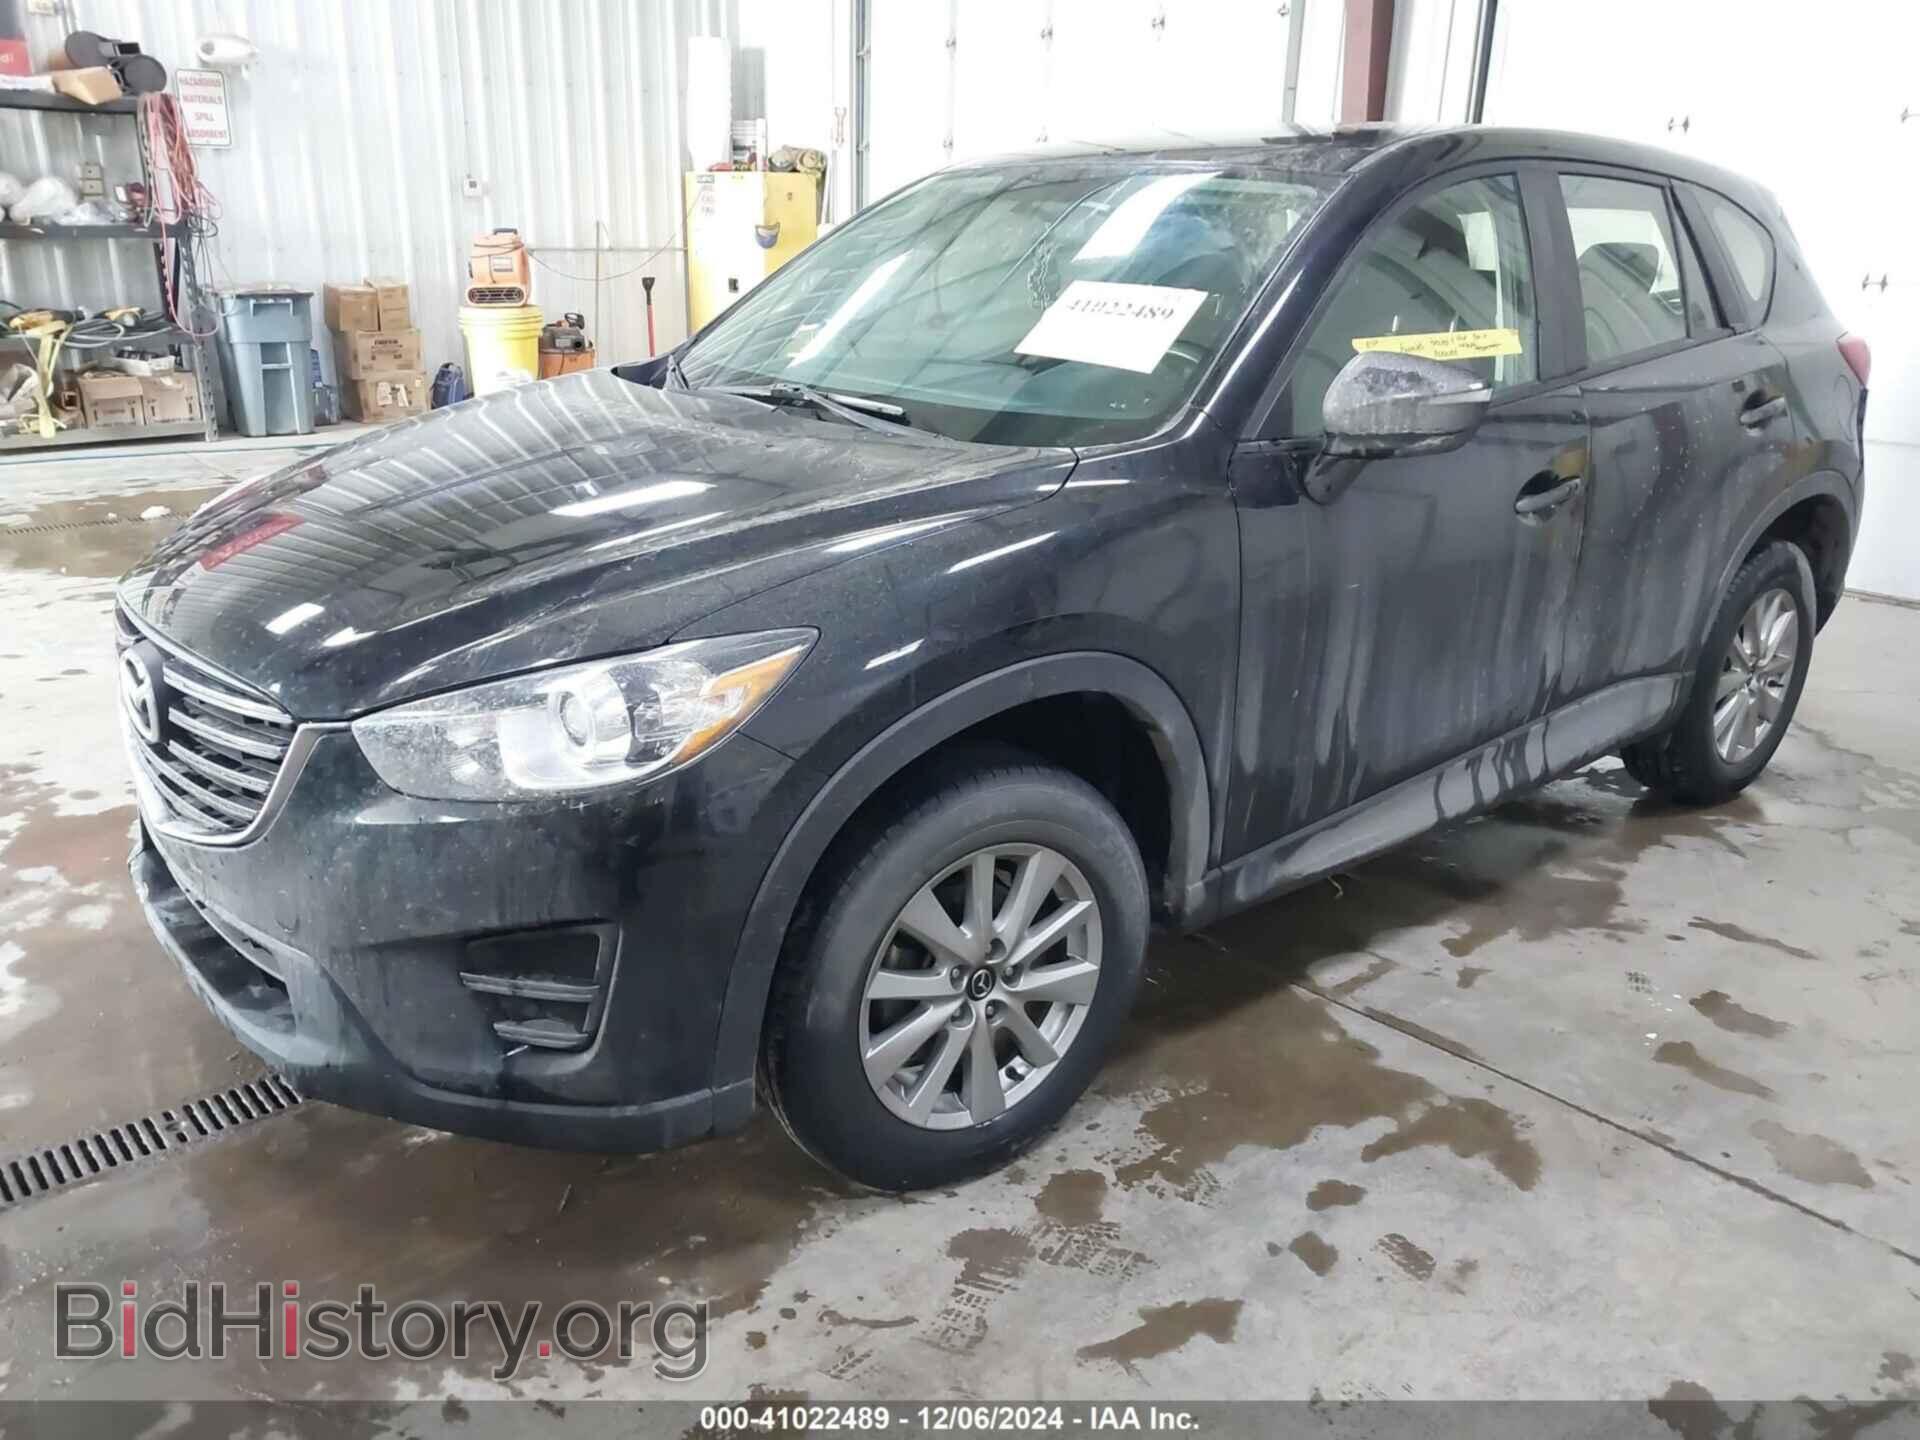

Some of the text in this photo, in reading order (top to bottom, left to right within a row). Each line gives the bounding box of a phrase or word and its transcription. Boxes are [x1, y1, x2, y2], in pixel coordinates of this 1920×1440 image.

[183, 95, 223, 104] MATERIALS
[194, 112, 216, 121] SPILL
[1066, 299, 1174, 319] 41022489
